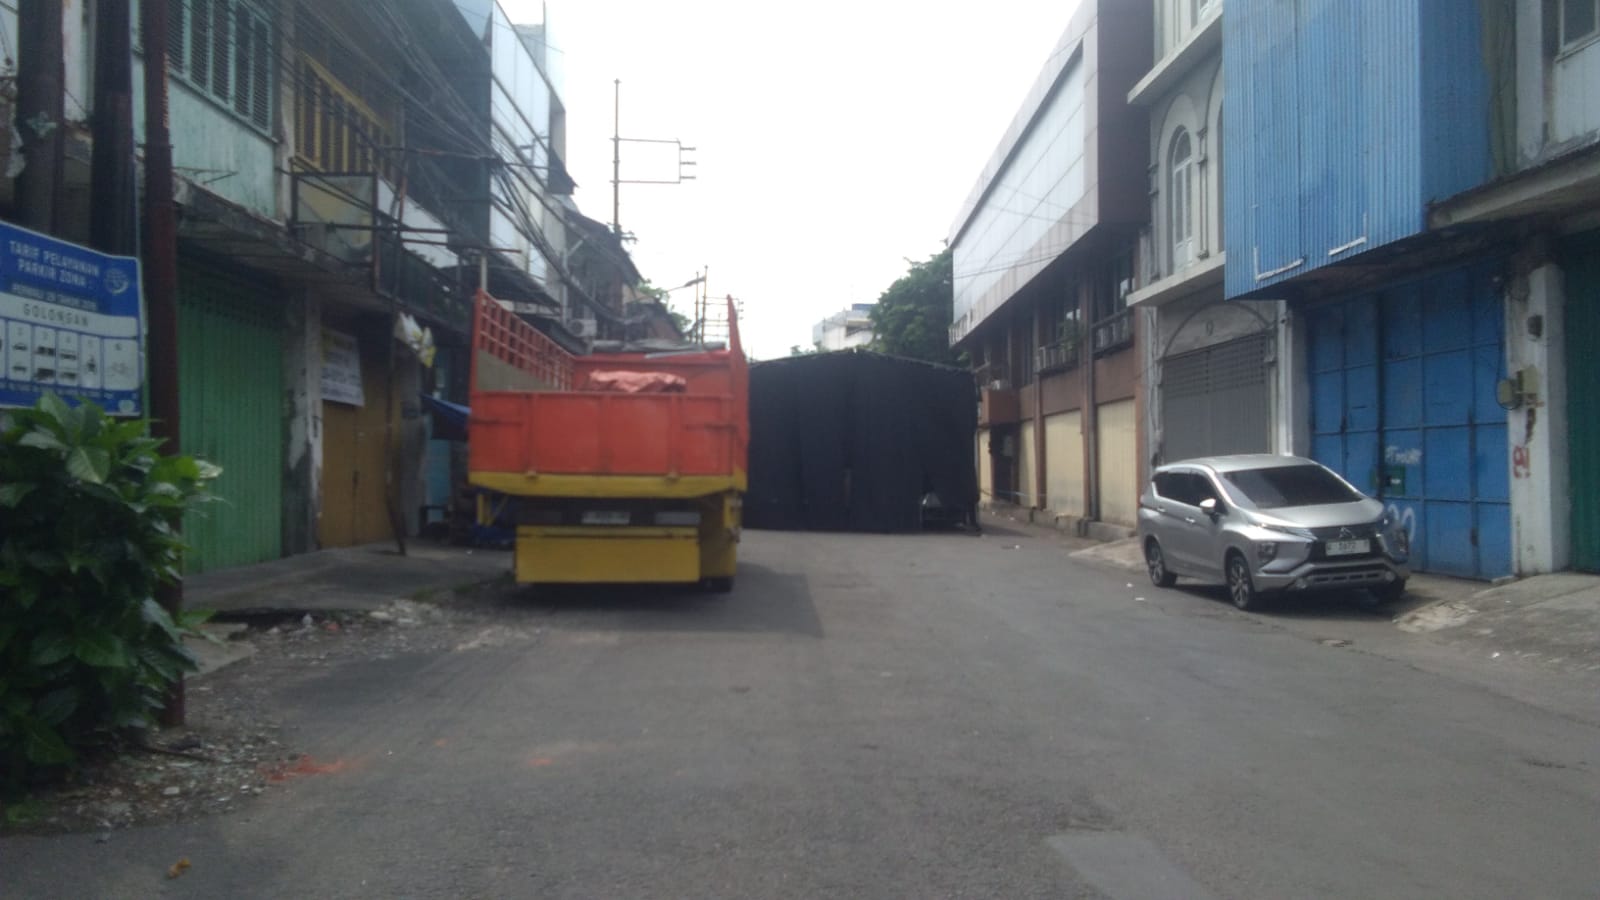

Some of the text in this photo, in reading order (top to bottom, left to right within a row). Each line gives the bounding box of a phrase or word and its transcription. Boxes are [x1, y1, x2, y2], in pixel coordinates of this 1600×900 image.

[9, 240, 99, 275] TARIF PELAYANAN
[18, 258, 56, 279] PARKIR
[23, 303, 88, 326] GOLONGAN
